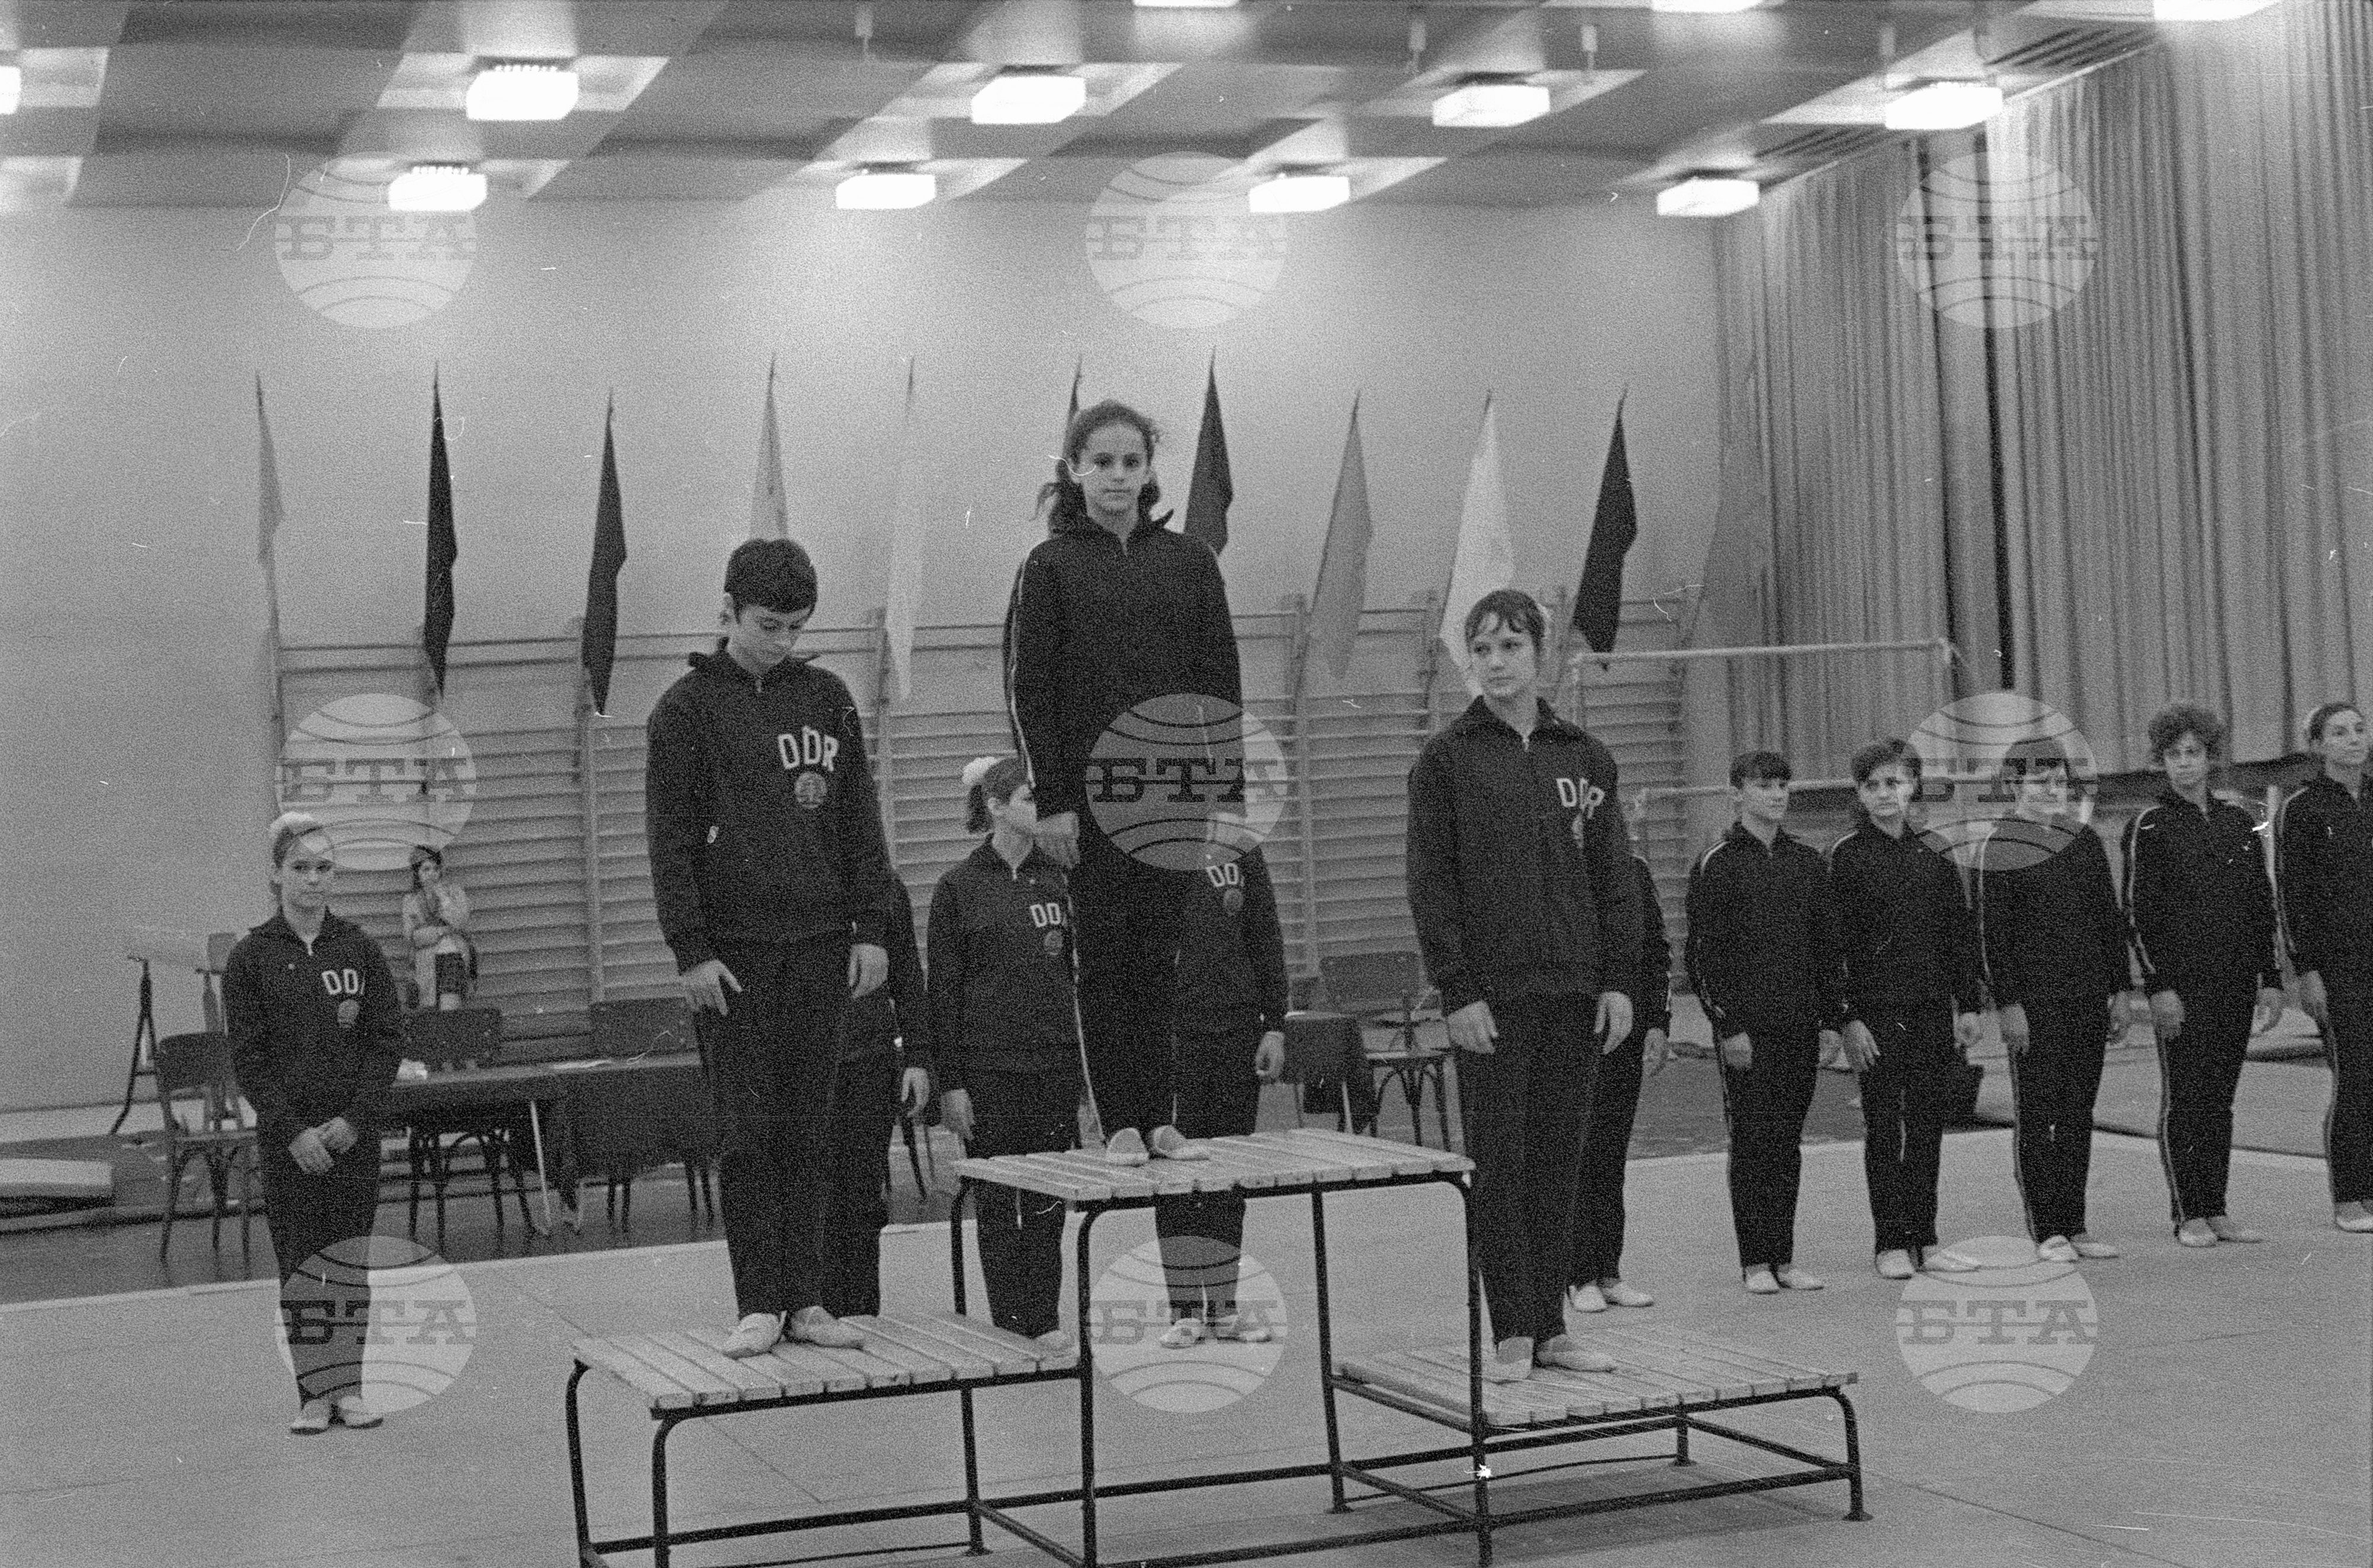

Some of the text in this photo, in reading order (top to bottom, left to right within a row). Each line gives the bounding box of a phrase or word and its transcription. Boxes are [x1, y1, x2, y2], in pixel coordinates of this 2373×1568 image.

[777, 725, 839, 772] DDR
[1029, 902, 1067, 928] DD
[321, 968, 365, 995] DD
